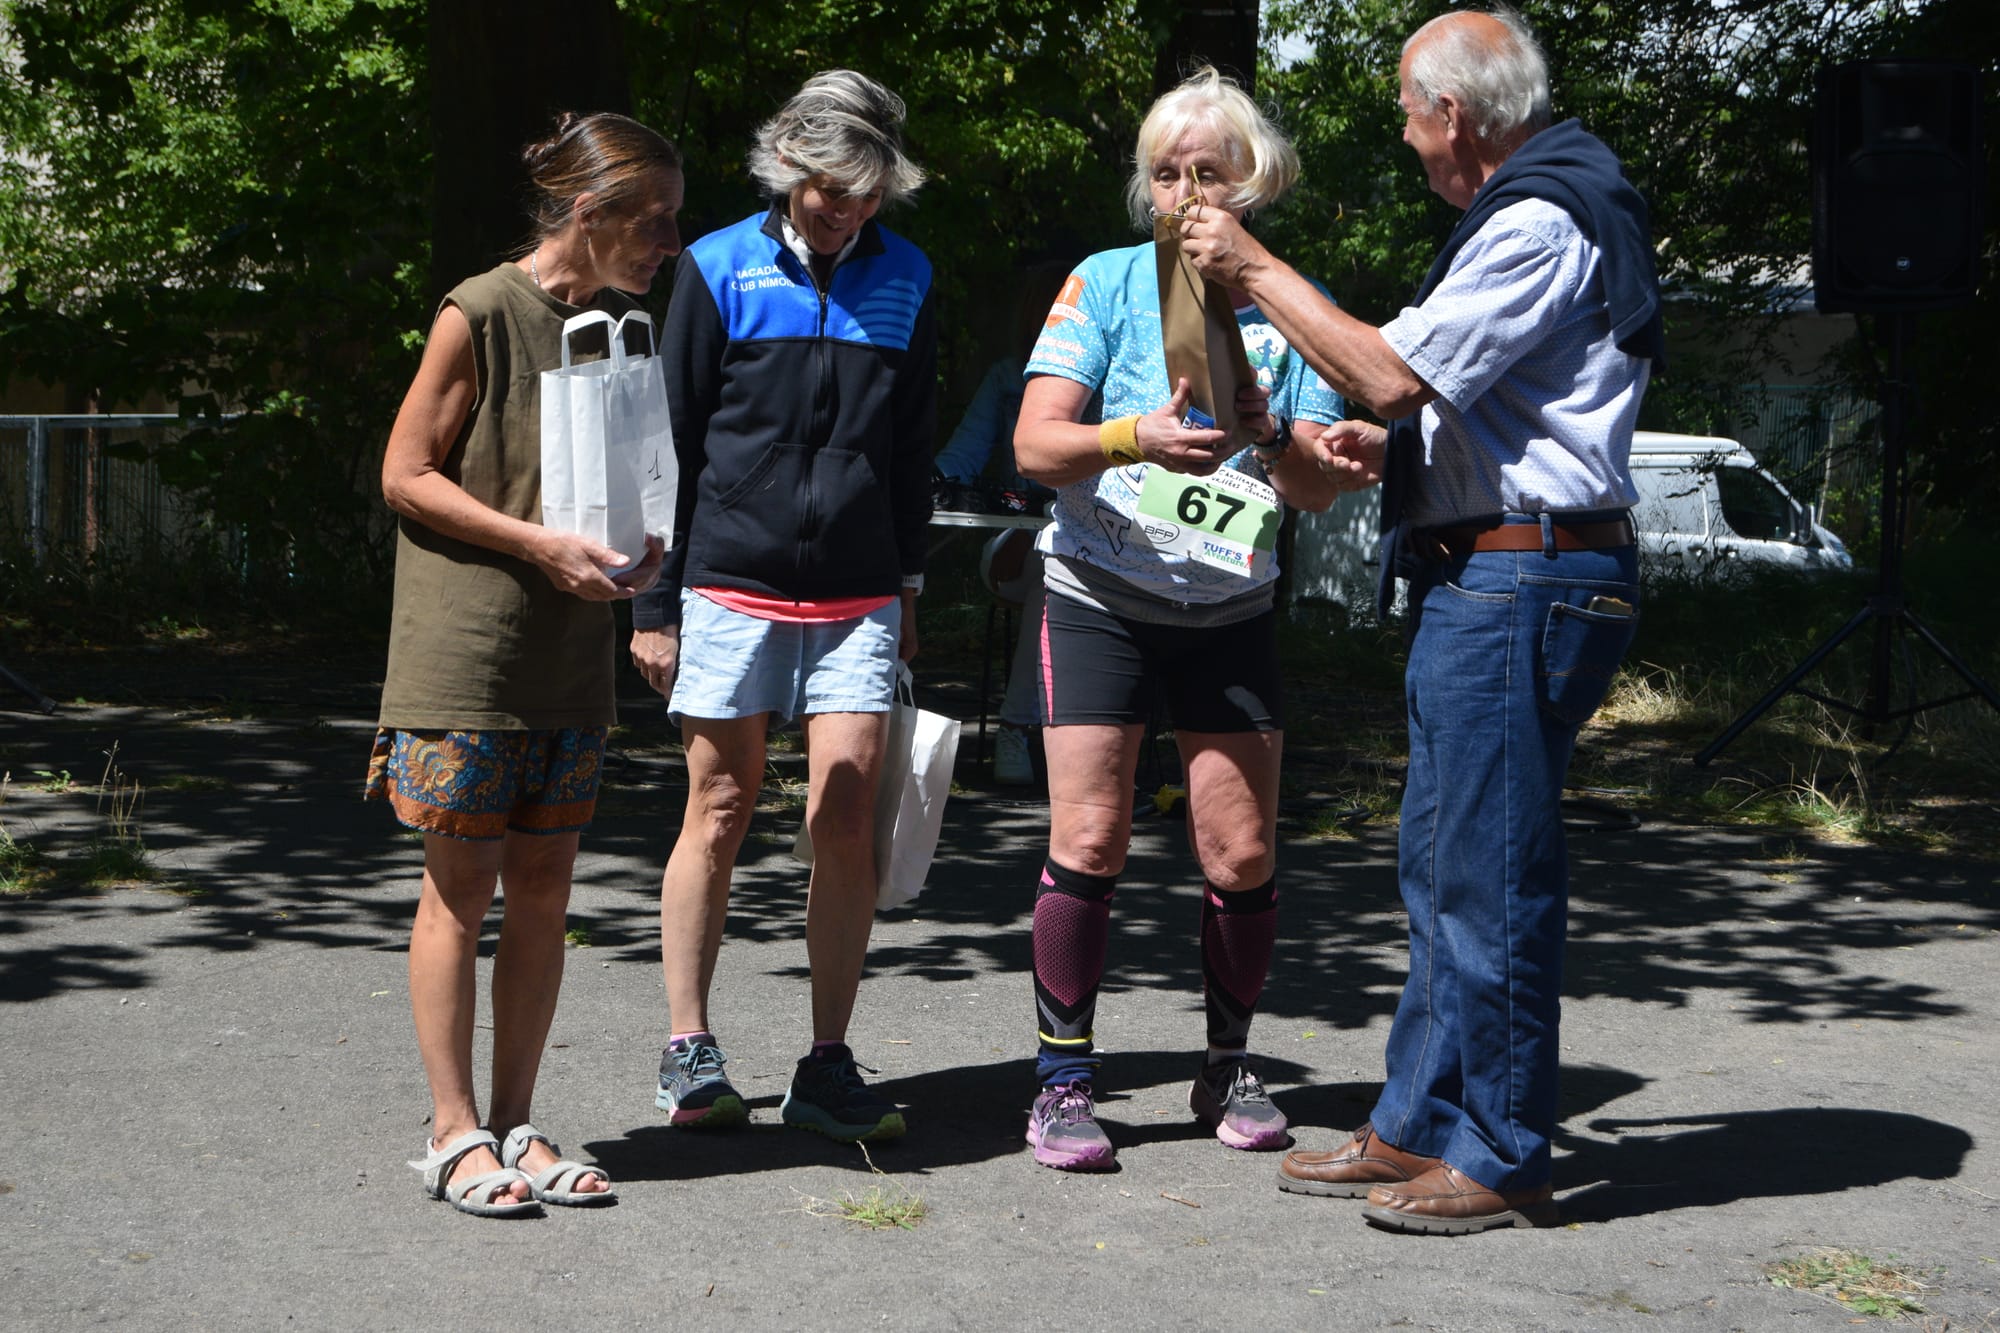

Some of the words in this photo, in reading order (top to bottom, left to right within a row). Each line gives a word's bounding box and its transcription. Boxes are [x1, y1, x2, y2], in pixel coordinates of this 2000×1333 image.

[734, 264, 783, 279] ACADA
[731, 279, 756, 292] CUB
[647, 449, 662, 480] 1
[1218, 469, 1258, 489] Challenge
[1261, 487, 1275, 497] des
[1177, 485, 1246, 533] 67
[1144, 525, 1175, 539] BFP
[1203, 541, 1242, 561] TUFF'S
